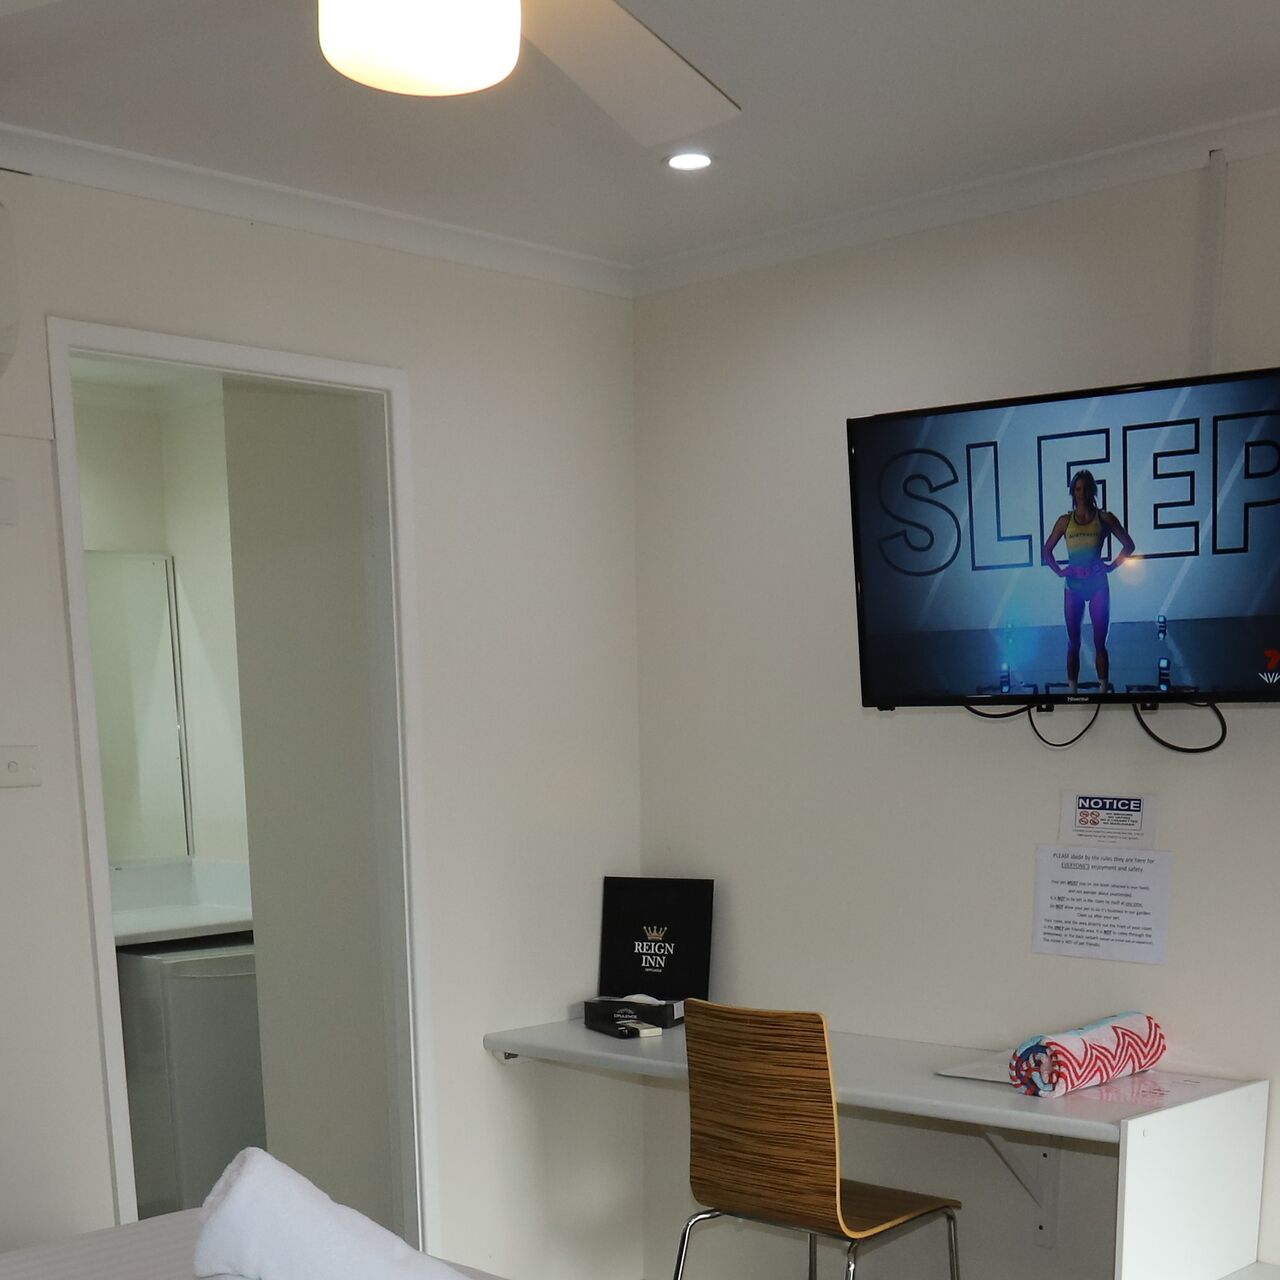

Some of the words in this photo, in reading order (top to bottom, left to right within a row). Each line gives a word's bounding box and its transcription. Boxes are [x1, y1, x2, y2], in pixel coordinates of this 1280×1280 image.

[1078, 798, 1141, 811] NOTICE
[633, 941, 675, 955] REIGN
[641, 955, 666, 968] INN
